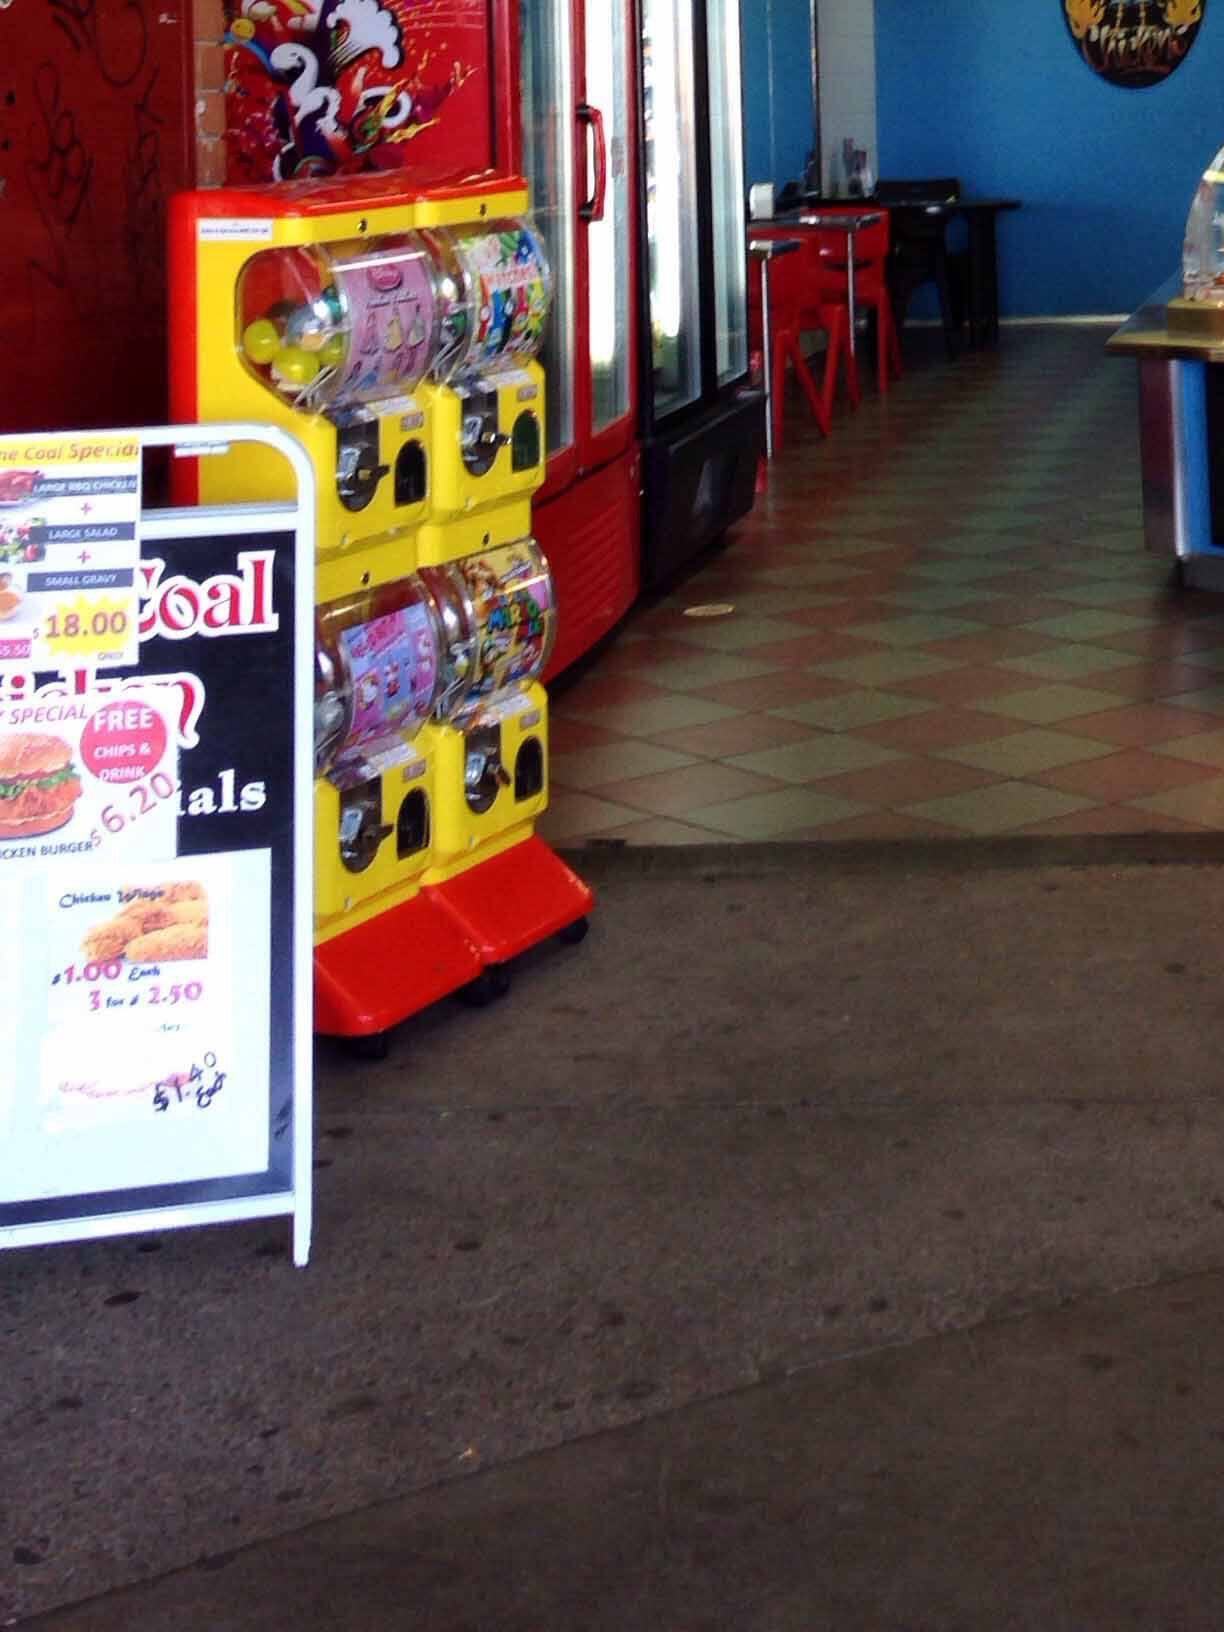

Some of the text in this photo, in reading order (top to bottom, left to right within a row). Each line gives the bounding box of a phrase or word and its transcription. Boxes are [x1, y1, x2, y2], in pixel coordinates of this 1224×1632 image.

[24, 444, 64, 461] Coal
[49, 526, 118, 540] LARGE SALAD
[45, 574, 117, 586] SMALL GRAVY
[46, 611, 127, 639] 18.00
[8, 704, 88, 725] SPECIAL
[94, 708, 154, 732] FREE
[94, 743, 151, 759] CHIPS &
[100, 765, 146, 781] DRINK
[101, 772, 174, 833] 6.20
[40, 840, 92, 857] BURGER
[59, 891, 112, 909] Chicken
[88, 989, 101, 1012] 3
[106, 996, 125, 1009] for
[148, 981, 203, 1005] 2.50
